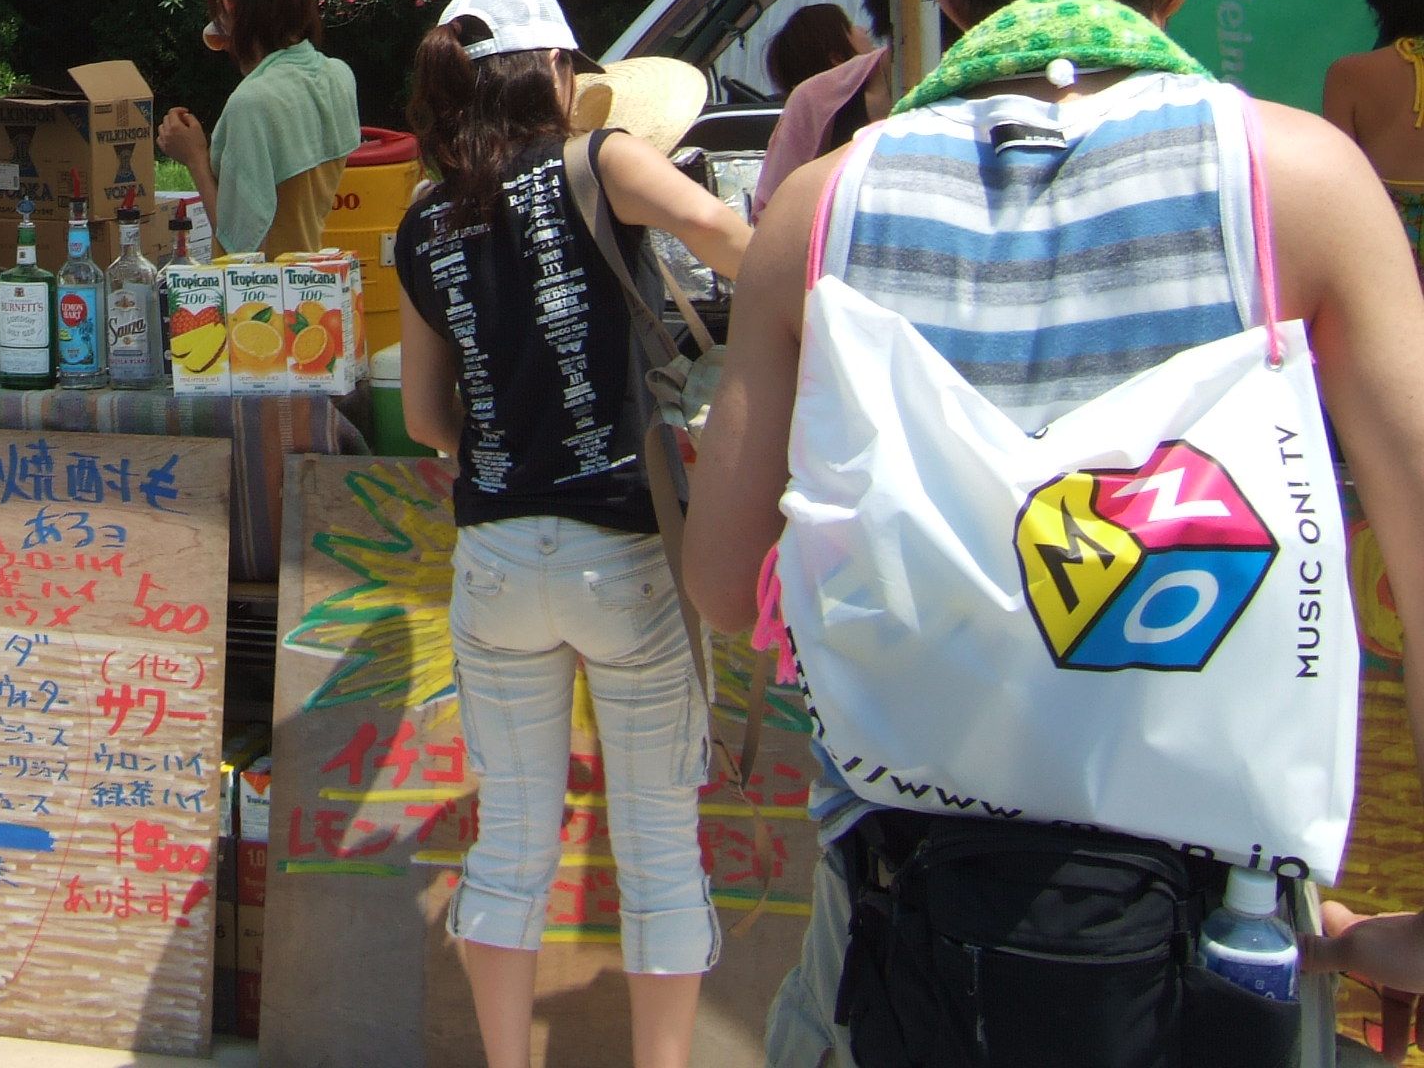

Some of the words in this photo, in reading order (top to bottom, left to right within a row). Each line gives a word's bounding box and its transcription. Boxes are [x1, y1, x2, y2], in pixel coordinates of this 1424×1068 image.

[96, 126, 151, 144] WILKINSON
[104, 183, 147, 201] VODA
[169, 272, 220, 289] Tropicana
[227, 270, 279, 286] Tropicana
[284, 269, 336, 285] Tropicana
[61, 303, 83, 312] LEMON
[109, 318, 147, 346] Sauza
[1275, 425, 1303, 465] TV
[128, 571, 210, 635] 500
[1295, 560, 1323, 678] MUSIC
[96, 684, 207, 737] サワー
[320, 719, 468, 788] イチゴ
[287, 807, 399, 858] レモン
